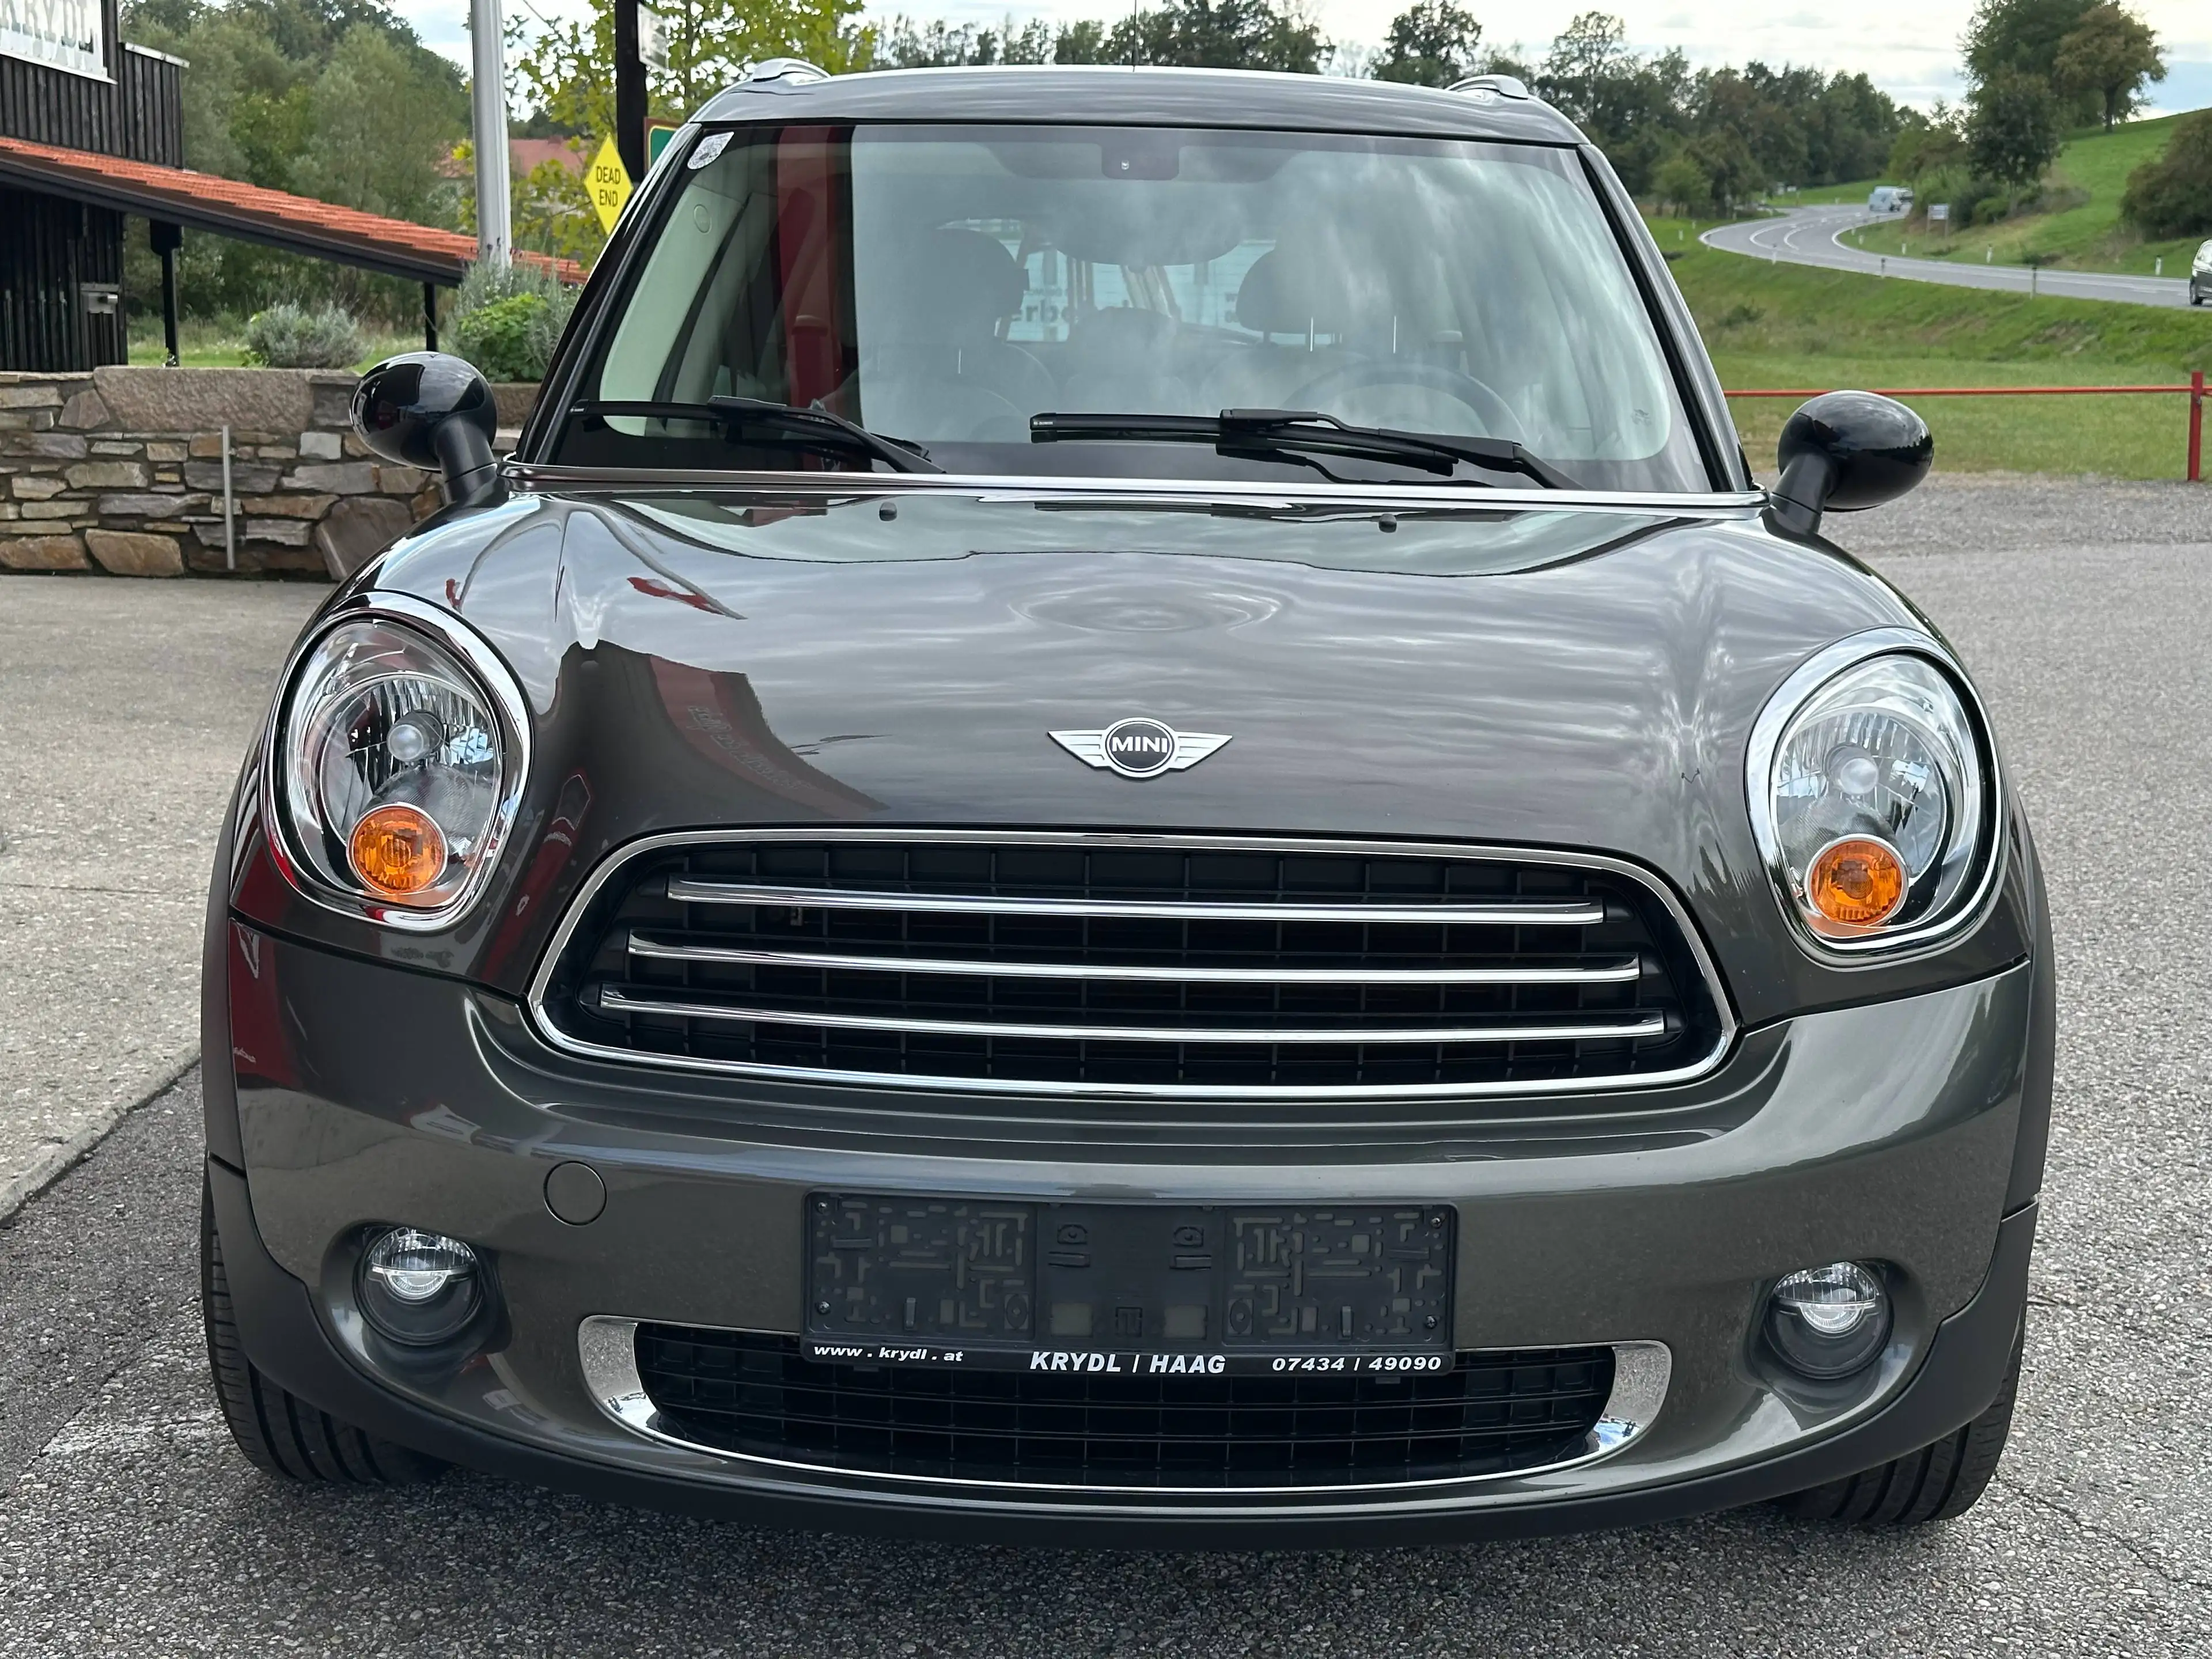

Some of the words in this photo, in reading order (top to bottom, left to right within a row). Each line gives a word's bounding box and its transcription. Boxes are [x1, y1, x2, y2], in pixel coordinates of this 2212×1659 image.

[596, 165, 621, 184] DEAD
[599, 189, 618, 207] END
[1112, 736, 1168, 753] MINI
[1030, 1351, 1121, 1373] KRYDL
[1149, 1355, 1226, 1374] HAAG
[1271, 1357, 1345, 1371] 07434
[1368, 1357, 1441, 1370] 49090
